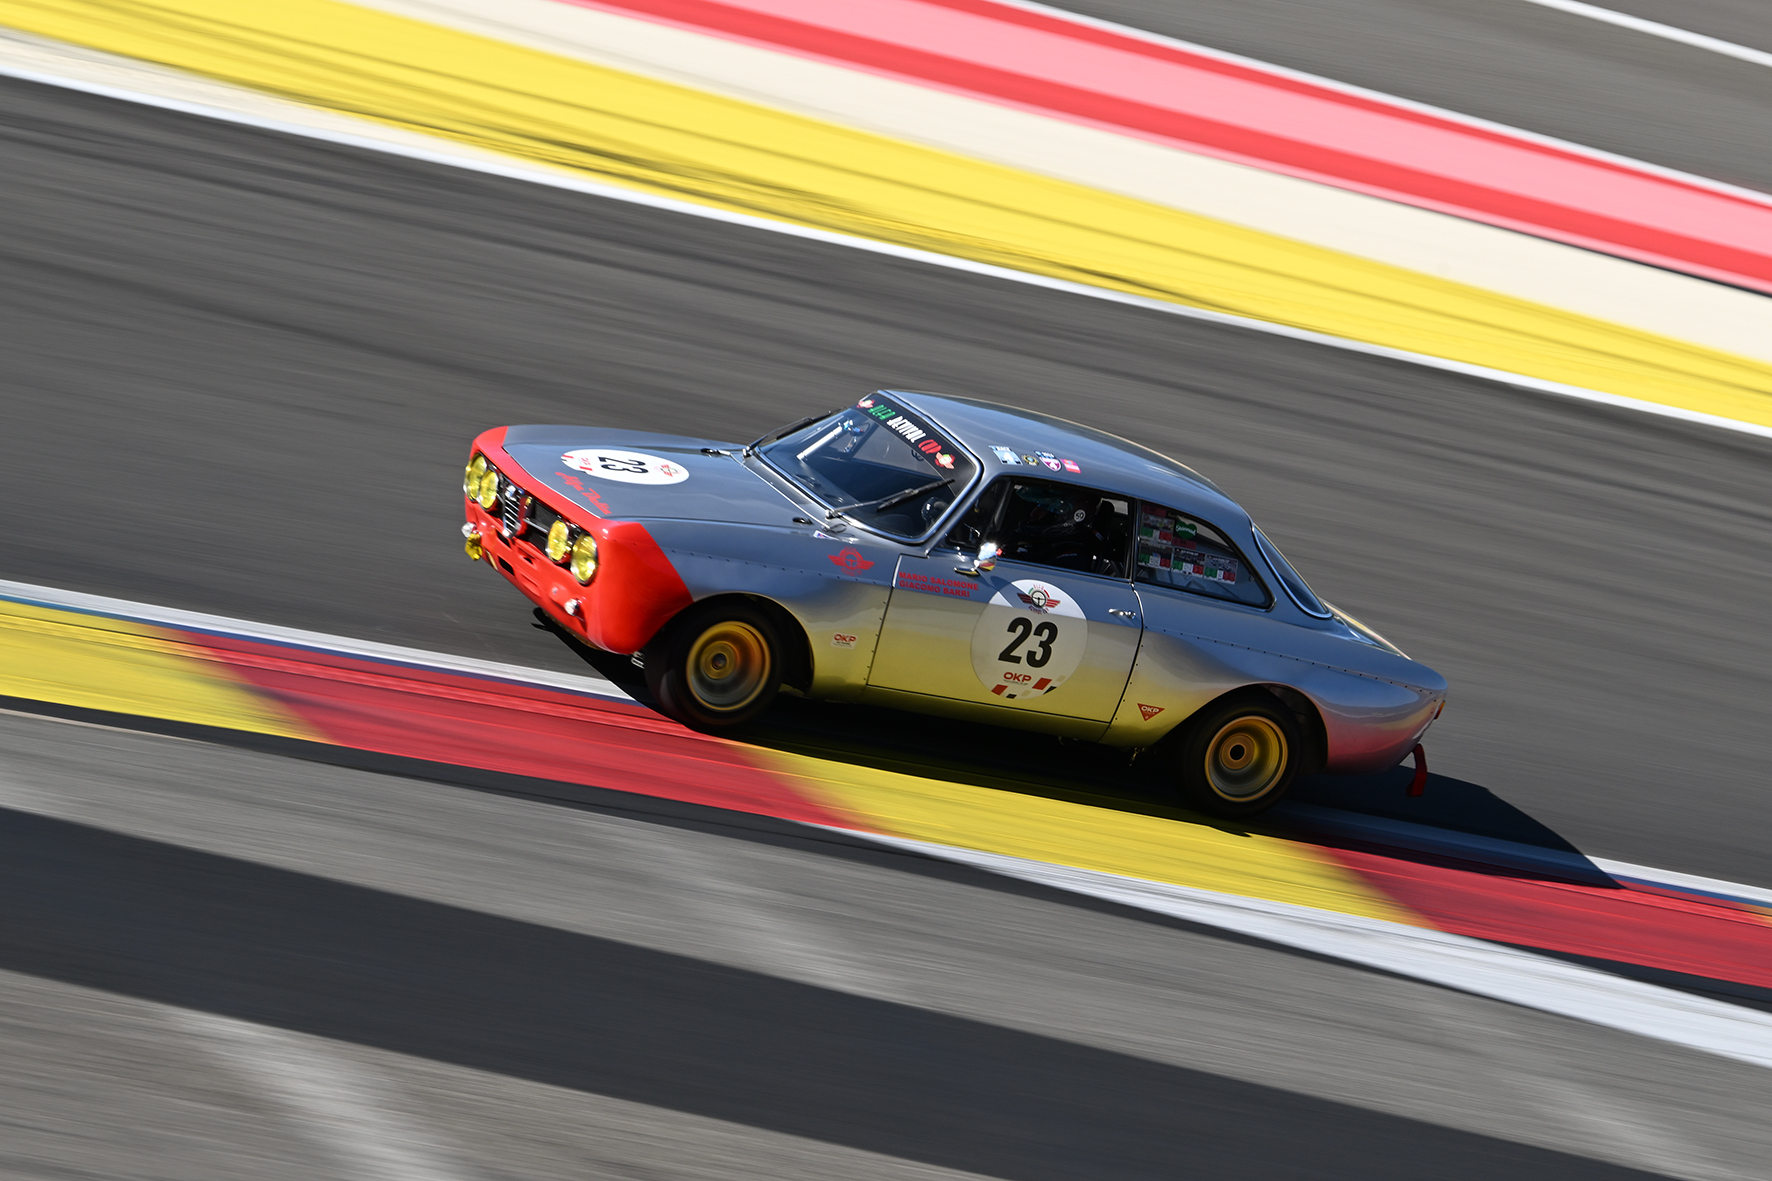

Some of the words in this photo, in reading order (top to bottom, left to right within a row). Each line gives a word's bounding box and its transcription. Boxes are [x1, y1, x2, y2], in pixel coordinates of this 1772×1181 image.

[868, 404, 896, 420] ALFA
[886, 416, 927, 443] REVIVAL
[918, 439, 942, 454] CUP
[598, 456, 649, 474] 23
[899, 571, 928, 583] MARIO
[930, 577, 980, 591] SALOMONE
[899, 580, 941, 593] GIACOMO
[943, 586, 971, 598] BARRI
[834, 633, 857, 643] OKP
[998, 616, 1058, 668] 23
[1003, 671, 1032, 683] OKP
[1141, 705, 1160, 713] OKP
